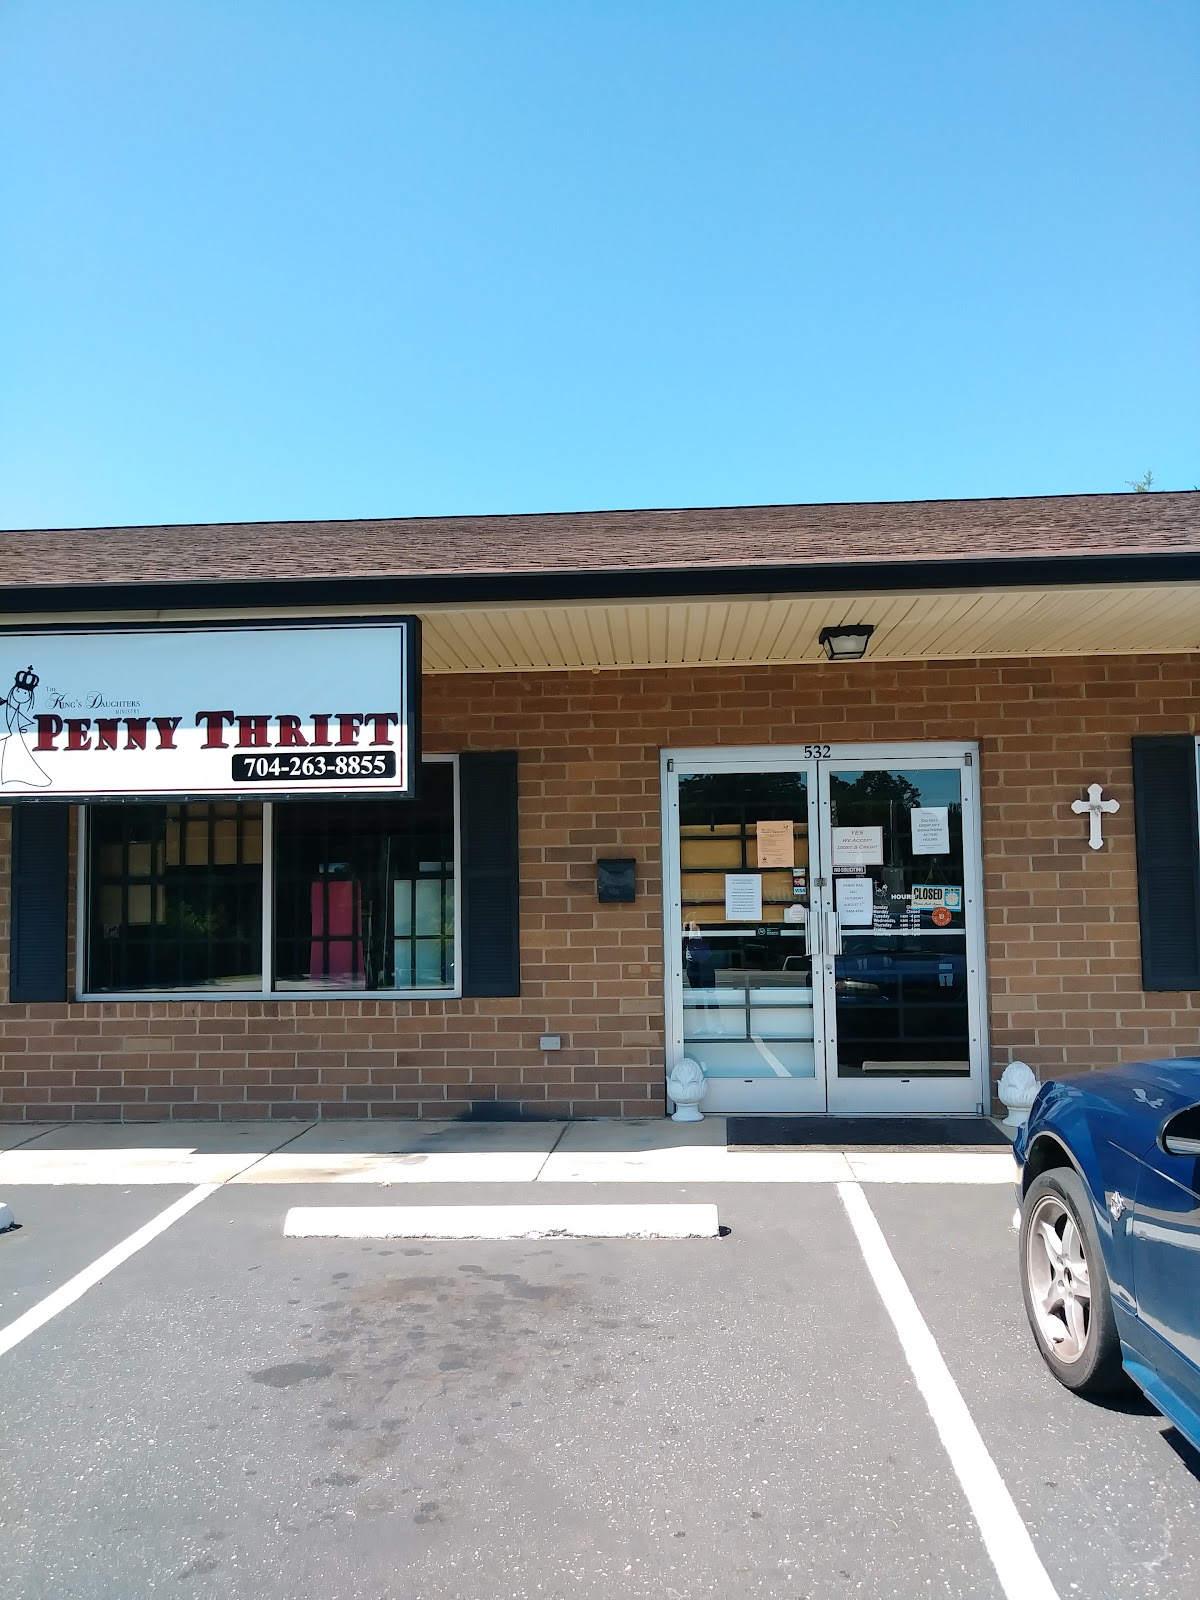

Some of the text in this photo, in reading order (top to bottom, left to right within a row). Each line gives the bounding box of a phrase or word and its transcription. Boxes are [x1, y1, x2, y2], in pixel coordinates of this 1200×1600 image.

[45, 691, 141, 709] KING'S DAUGHTERS
[32, 710, 399, 752] PENNY THRIFT
[804, 745, 831, 758] 532
[243, 754, 386, 777] 704-263-8855
[914, 887, 942, 900] CLOSED
